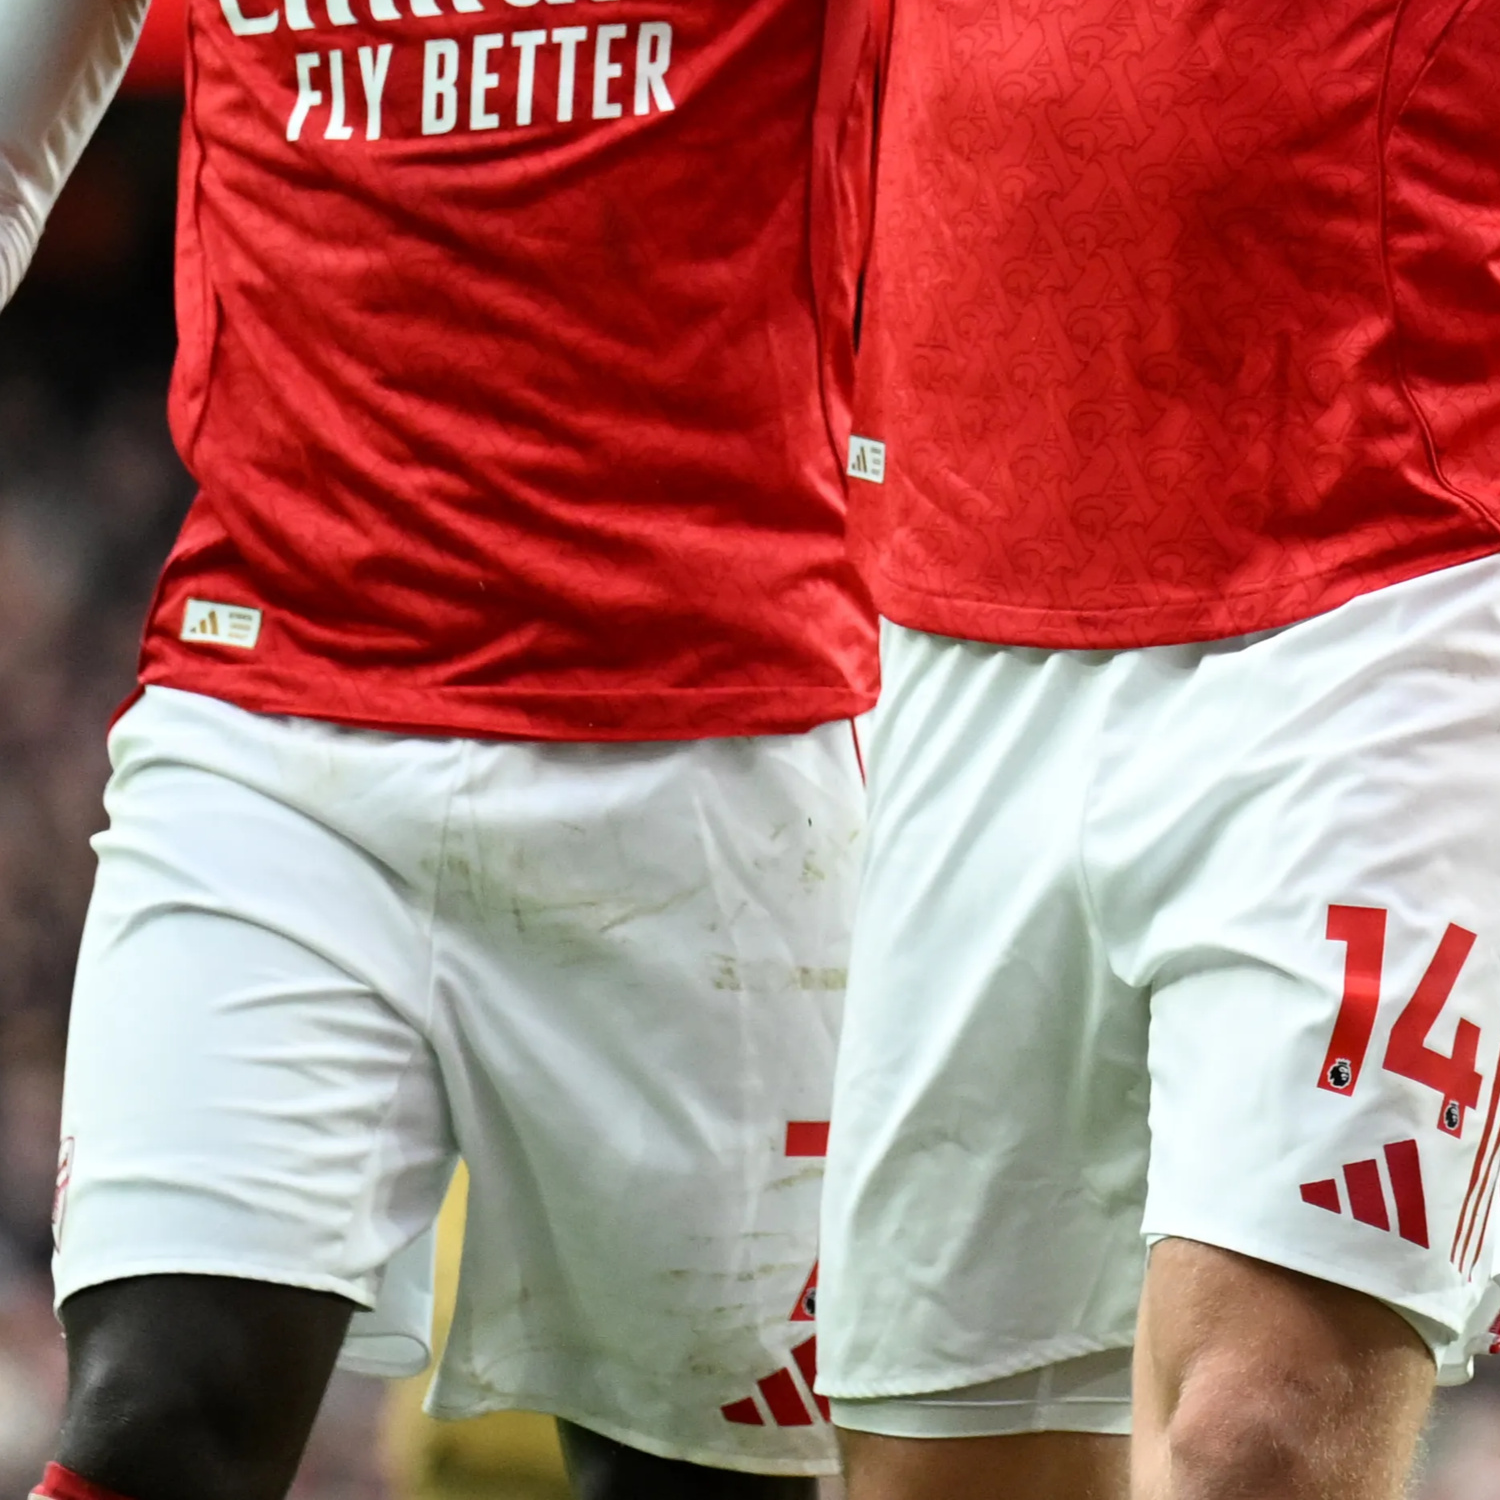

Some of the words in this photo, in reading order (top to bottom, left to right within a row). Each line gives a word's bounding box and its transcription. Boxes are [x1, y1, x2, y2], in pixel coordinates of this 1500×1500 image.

[286, 42, 393, 142] FLY
[421, 21, 675, 136] BETTER
[1316, 903, 1484, 1140] 14
